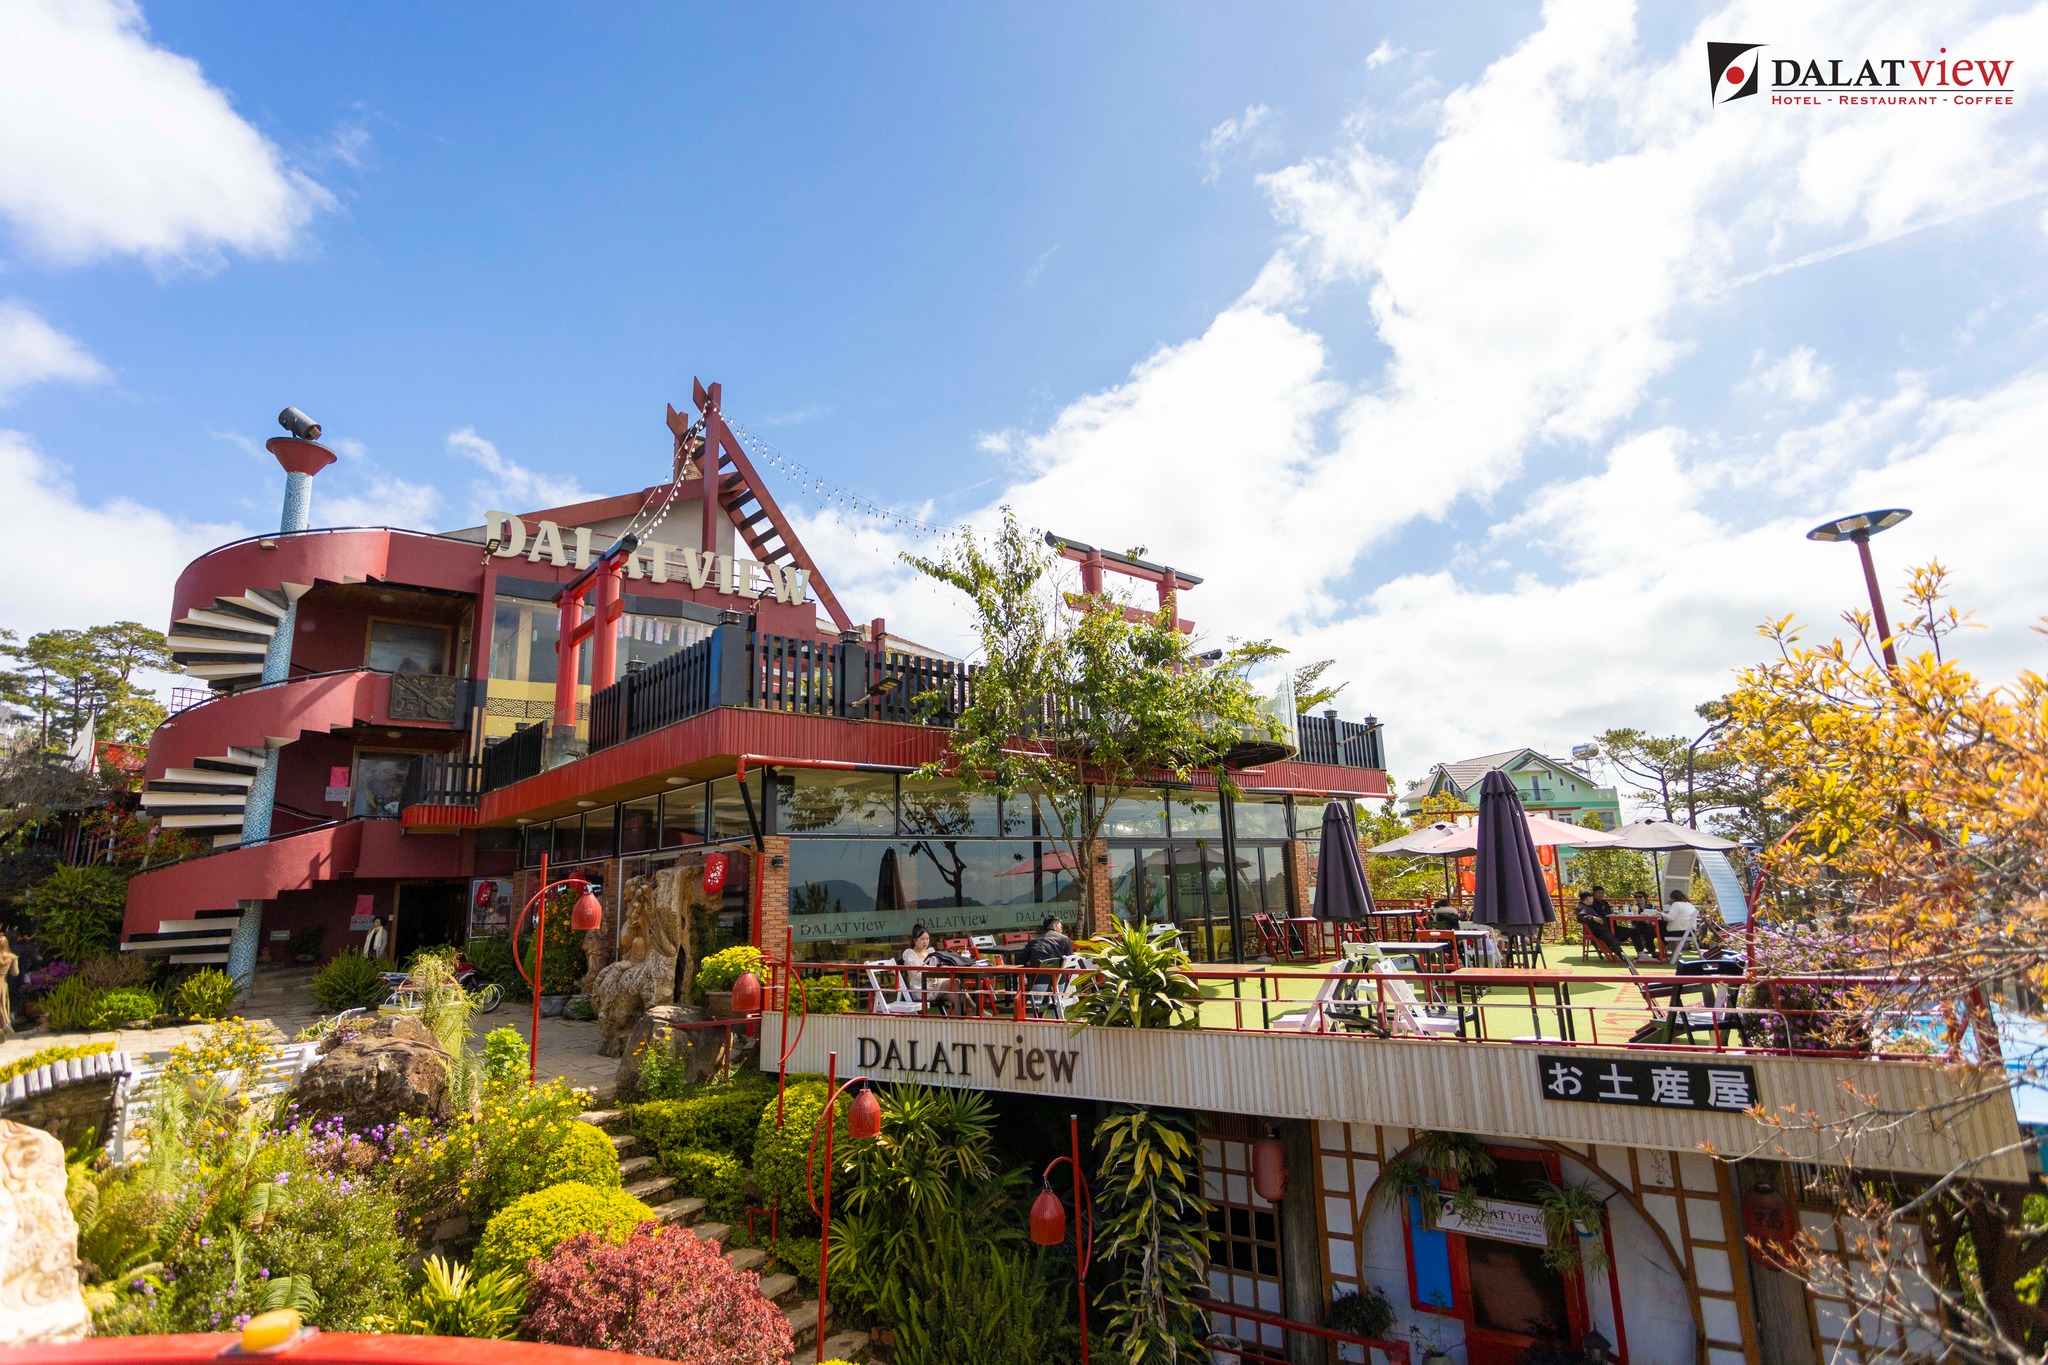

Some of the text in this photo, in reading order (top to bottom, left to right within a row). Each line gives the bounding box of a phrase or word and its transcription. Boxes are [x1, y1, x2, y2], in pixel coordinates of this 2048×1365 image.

[856, 1037, 976, 1076] DALAT
[1547, 1061, 1753, 1110] お土産屋
